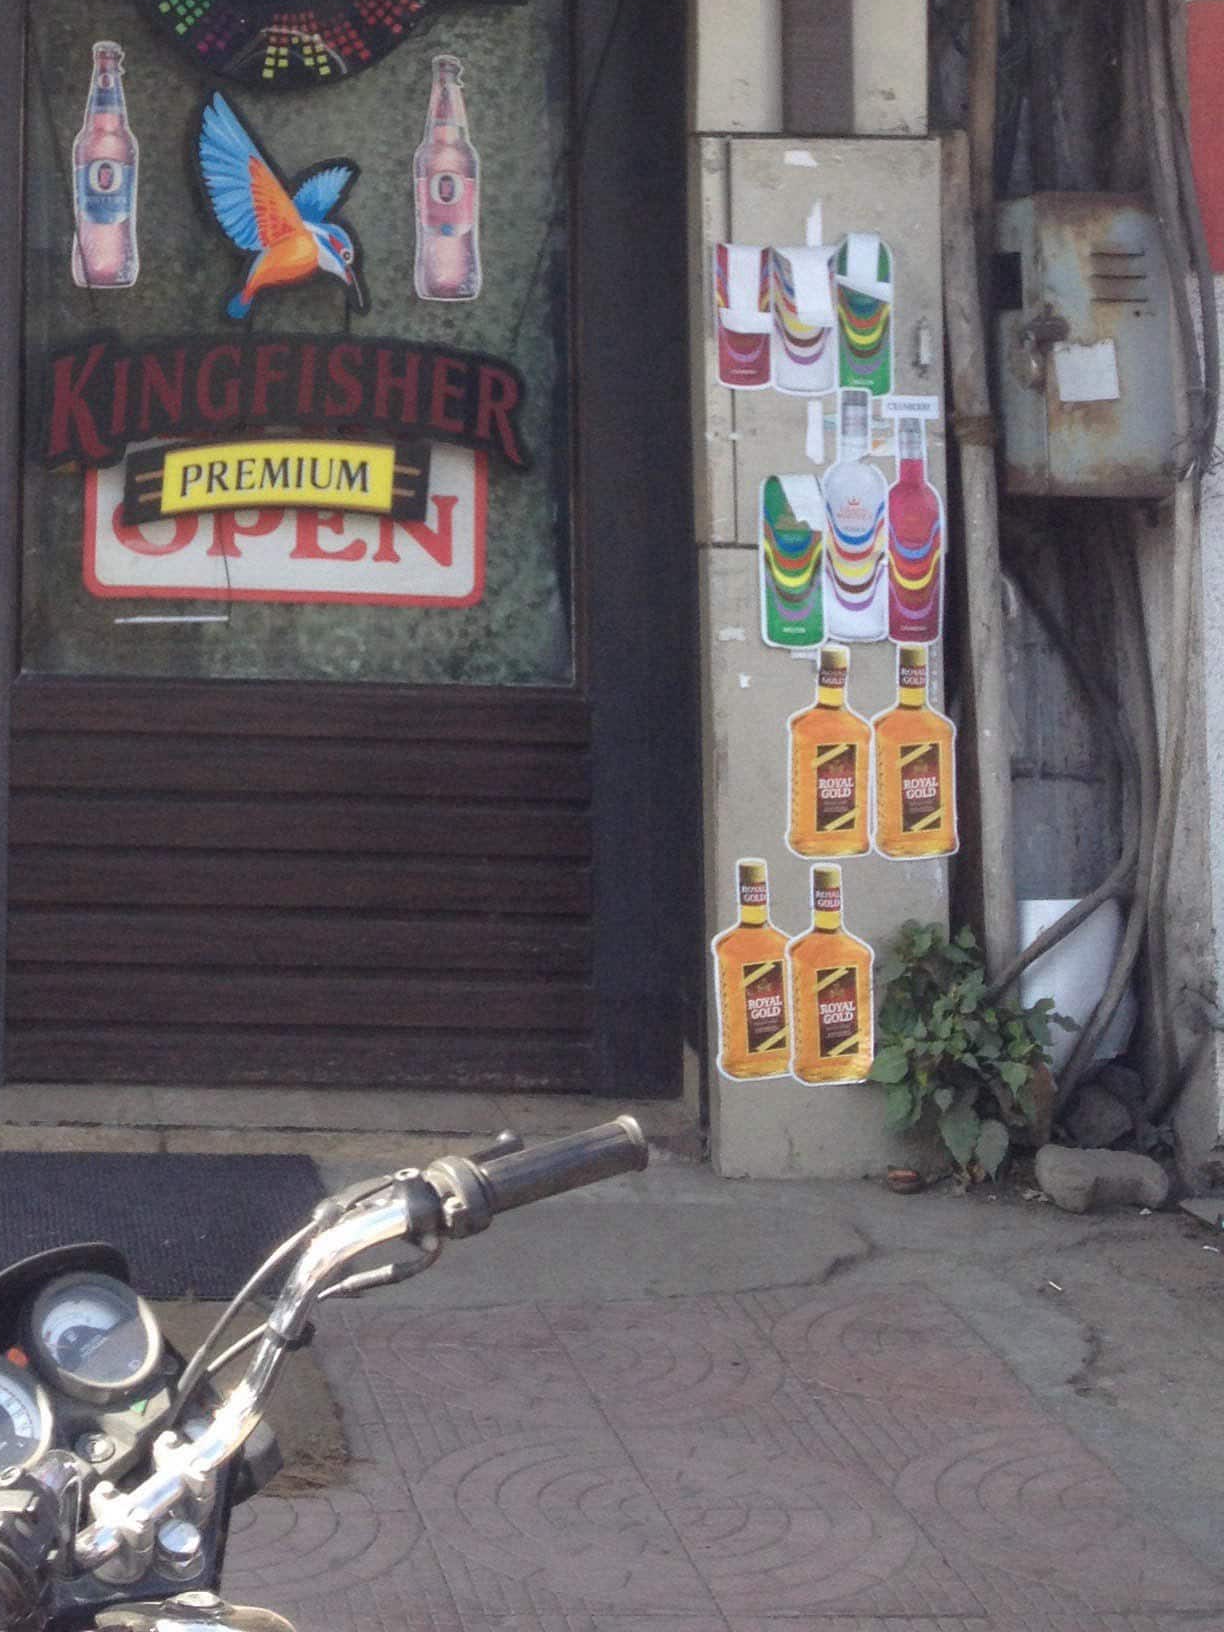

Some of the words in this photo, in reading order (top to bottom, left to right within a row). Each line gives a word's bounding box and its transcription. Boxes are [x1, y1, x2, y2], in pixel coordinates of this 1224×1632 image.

[49, 343, 522, 466] KINGFISHER
[179, 456, 370, 498] PREMIUM
[111, 495, 459, 568] OPEN
[818, 777, 854, 789] ROYAL
[903, 777, 938, 790] ROYAL
[820, 788, 852, 799] GOLD
[905, 788, 937, 799] GOLD
[747, 995, 783, 1010] ROYAL
[819, 1001, 856, 1015] ROYAL
[750, 1006, 782, 1020] GOLD
[822, 1011, 855, 1025] GOLD
